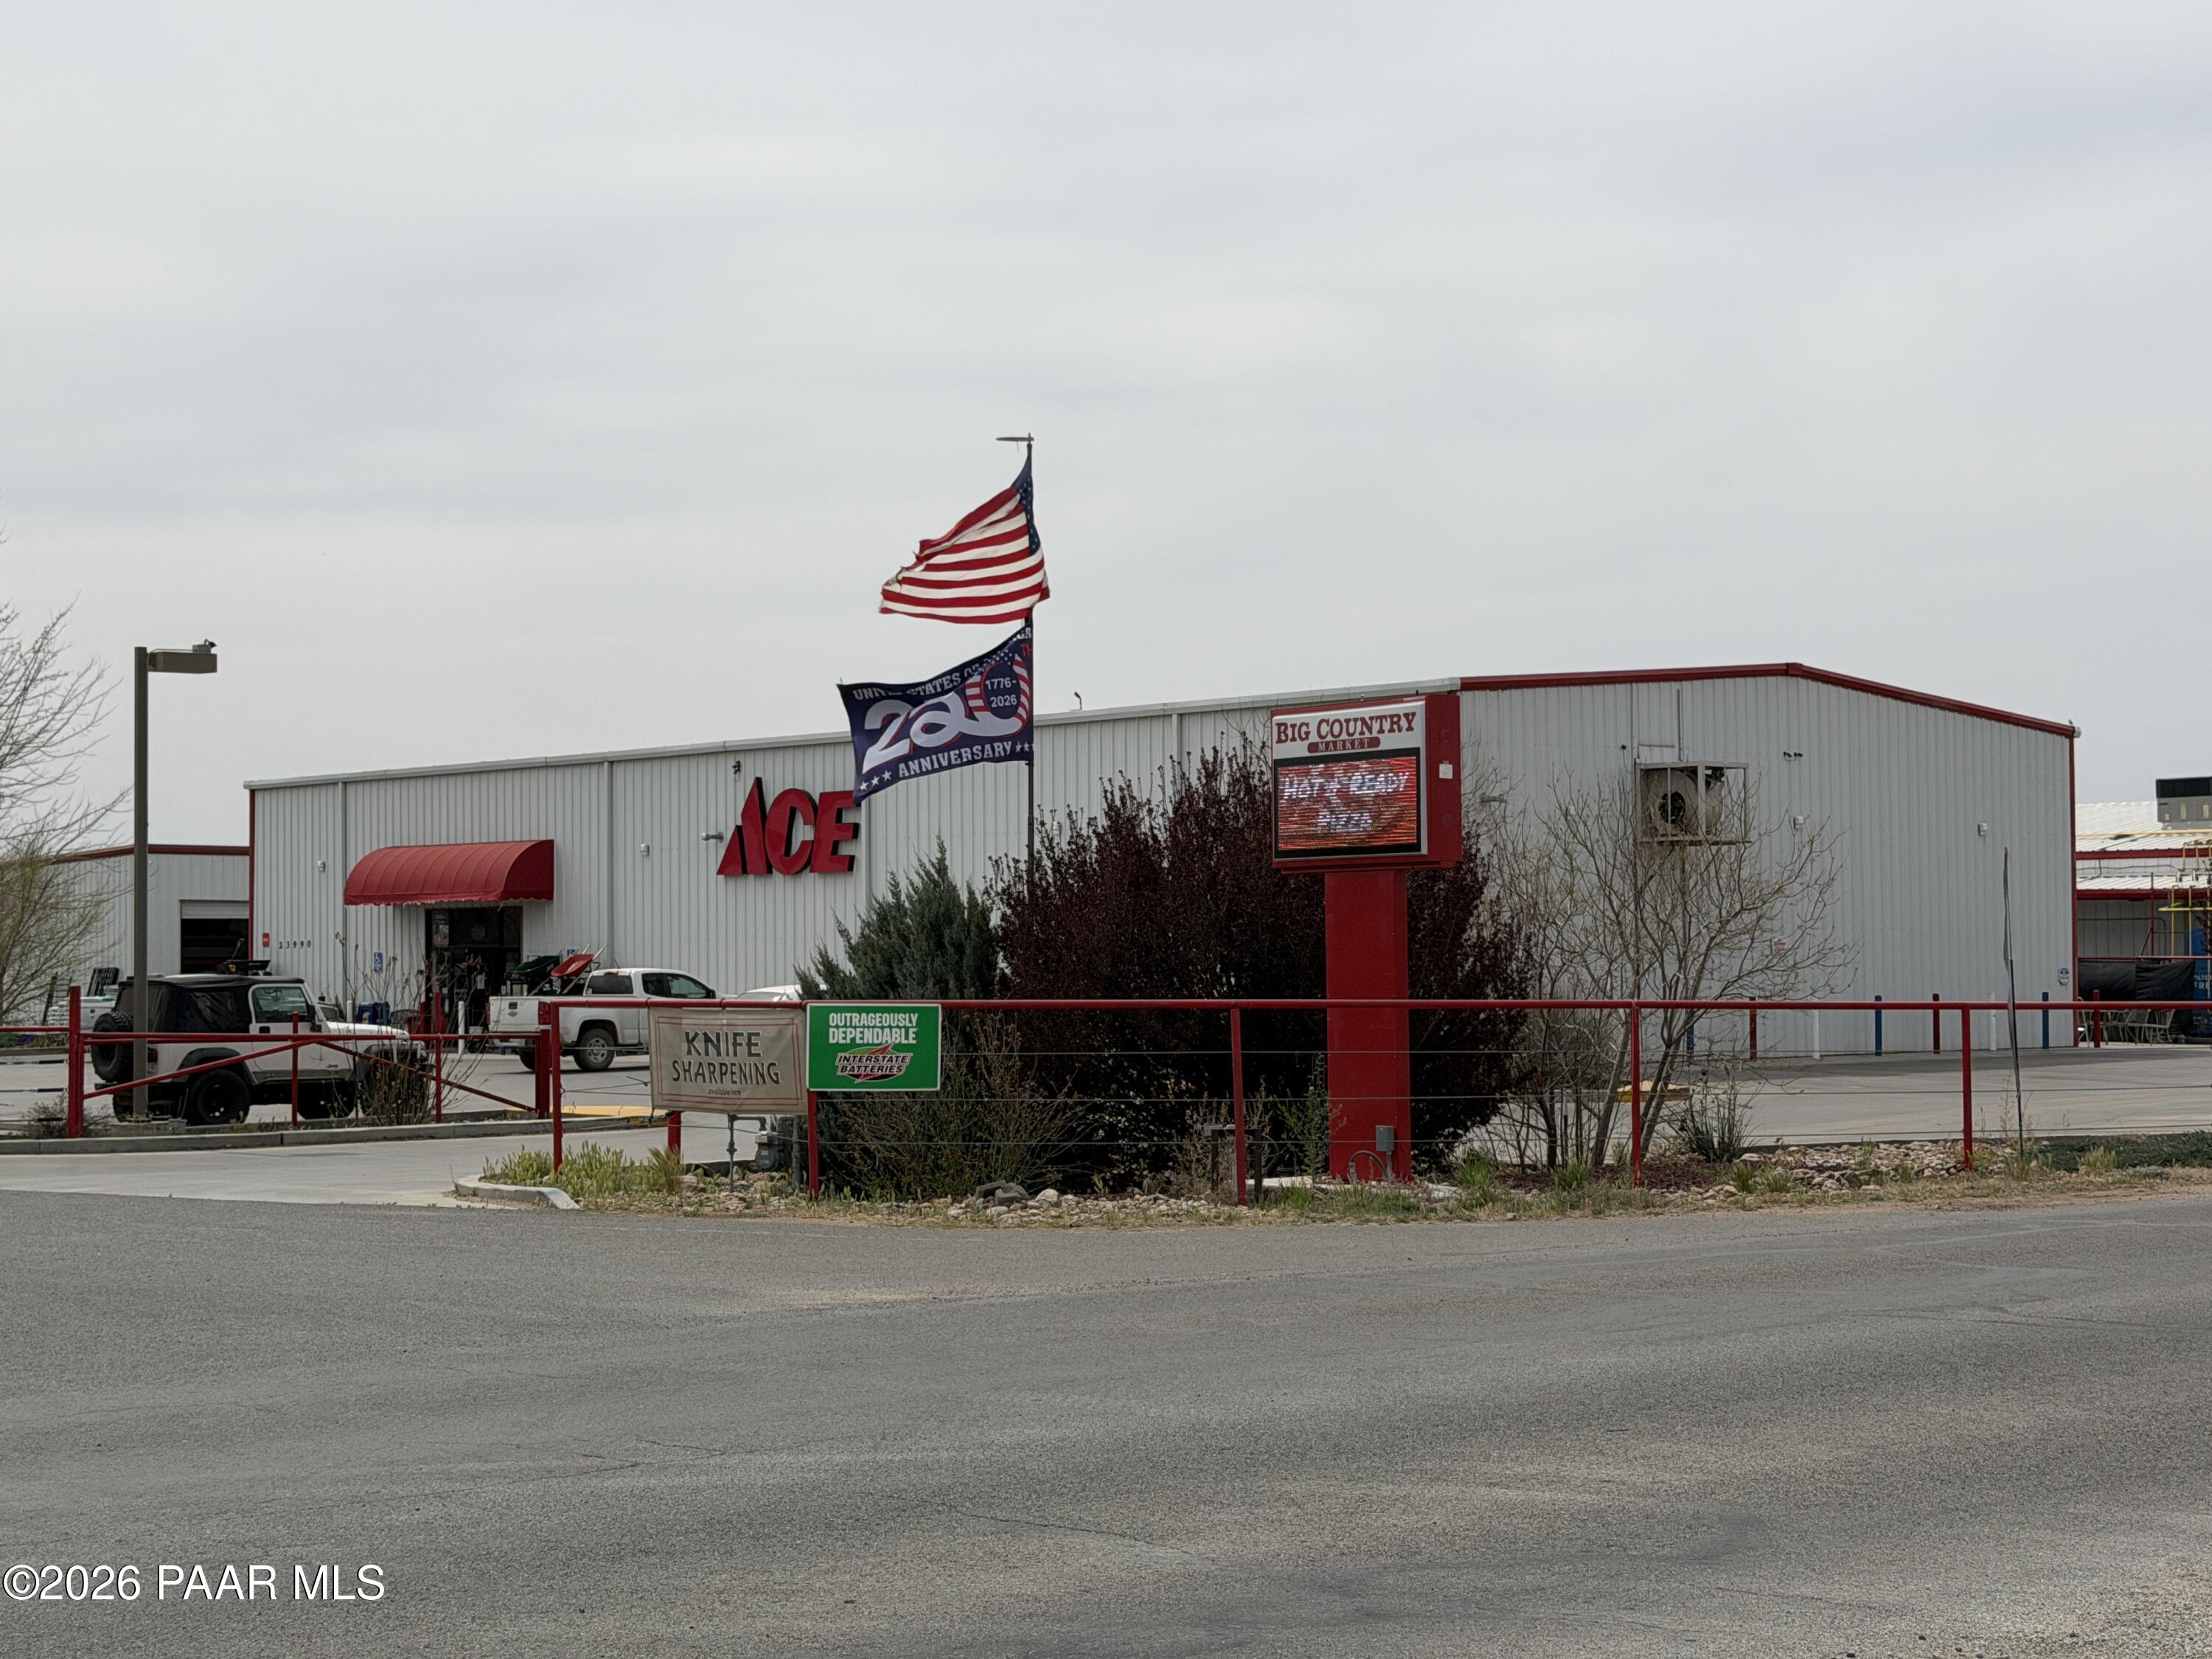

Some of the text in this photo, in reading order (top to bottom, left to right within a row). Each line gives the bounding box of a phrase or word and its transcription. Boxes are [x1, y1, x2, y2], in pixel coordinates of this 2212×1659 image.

[852, 687, 902, 700] UNI
[990, 694, 1018, 709] 2026
[1275, 712, 1416, 744] BIG COUNTRY
[1318, 739, 1370, 752] MARKET
[898, 740, 1012, 779] ANNIVERSARY
[717, 776, 860, 876] ACE
[829, 1012, 919, 1028] OUTRAGEOUSLY
[684, 1030, 762, 1057] KNIFE
[829, 1028, 917, 1044] DEPENDABLE
[838, 1054, 909, 1064] INTERSTATE
[672, 1060, 781, 1086] SHARPENING
[839, 1065, 904, 1074] BATTERIES
